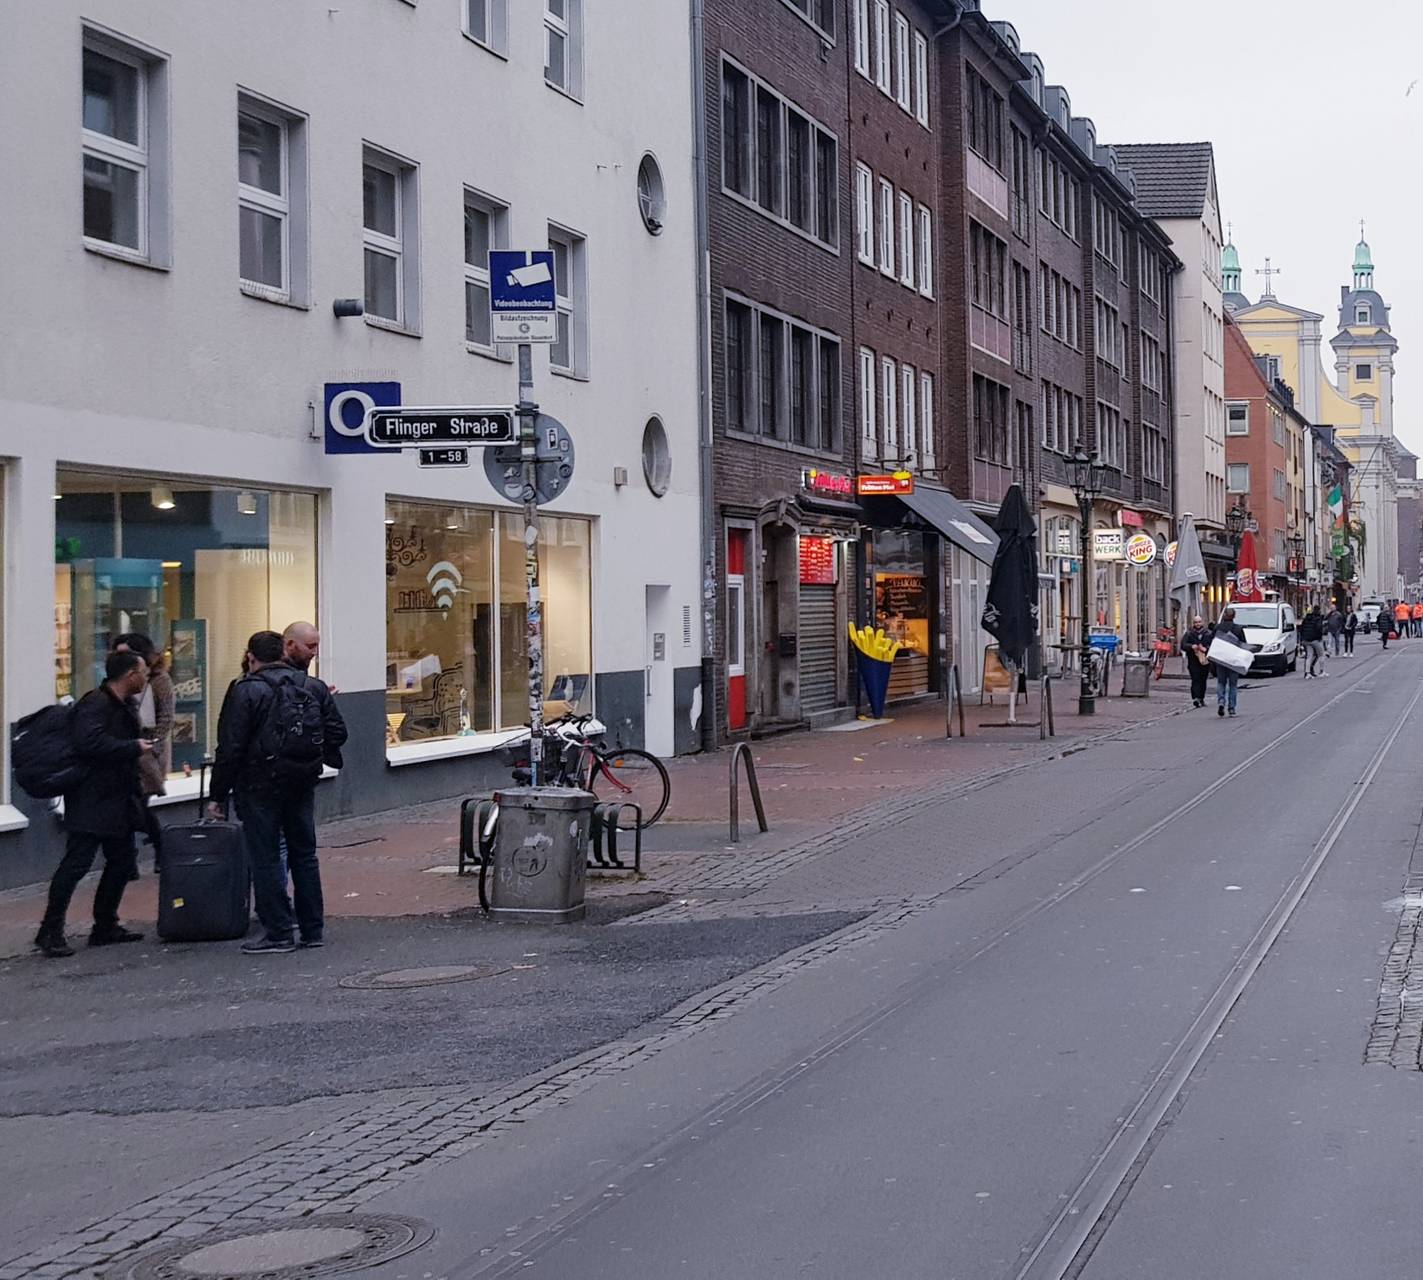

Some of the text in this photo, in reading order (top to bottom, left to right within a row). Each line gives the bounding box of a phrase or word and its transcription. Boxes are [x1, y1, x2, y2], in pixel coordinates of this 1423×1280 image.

[386, 417, 498, 438] Flinger Straße
[1095, 534, 1120, 544] back
[1095, 545, 1121, 554] WERK
[1129, 545, 1153, 558] KING
